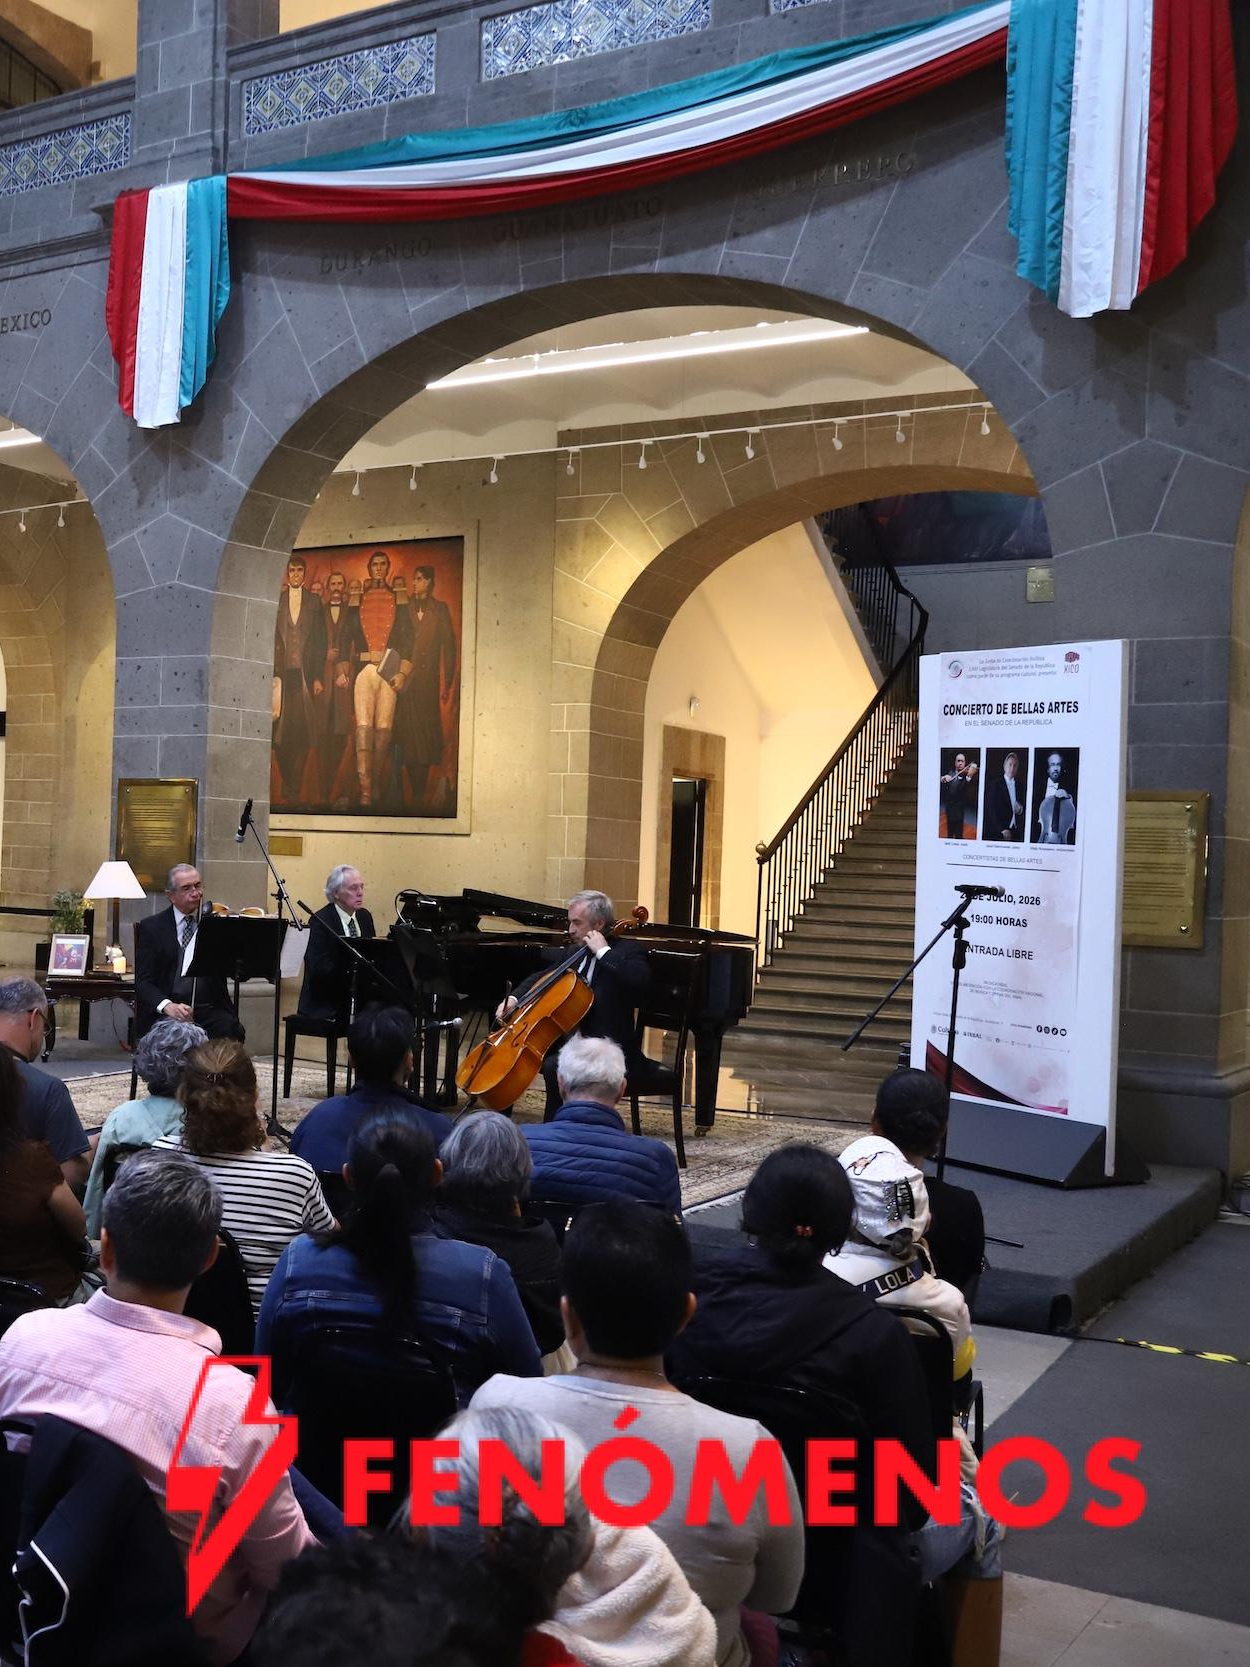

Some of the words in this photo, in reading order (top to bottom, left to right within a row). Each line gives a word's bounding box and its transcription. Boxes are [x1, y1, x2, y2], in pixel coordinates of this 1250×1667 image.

[318, 238, 432, 274] DURANGO
[943, 704, 993, 716] CONCIERTO
[996, 703, 1008, 715] DE
[1011, 702, 1045, 715] BELLAS
[1047, 701, 1079, 714] ARTES
[964, 719, 972, 727] EN
[1019, 895, 1041, 906] 2026
[970, 914, 994, 924] 19:00
[996, 916, 1028, 928] HORAS
[965, 945, 1005, 957] NTRADA
[1006, 949, 1034, 960] LIBRE
[874, 1266, 917, 1295] LOLA
